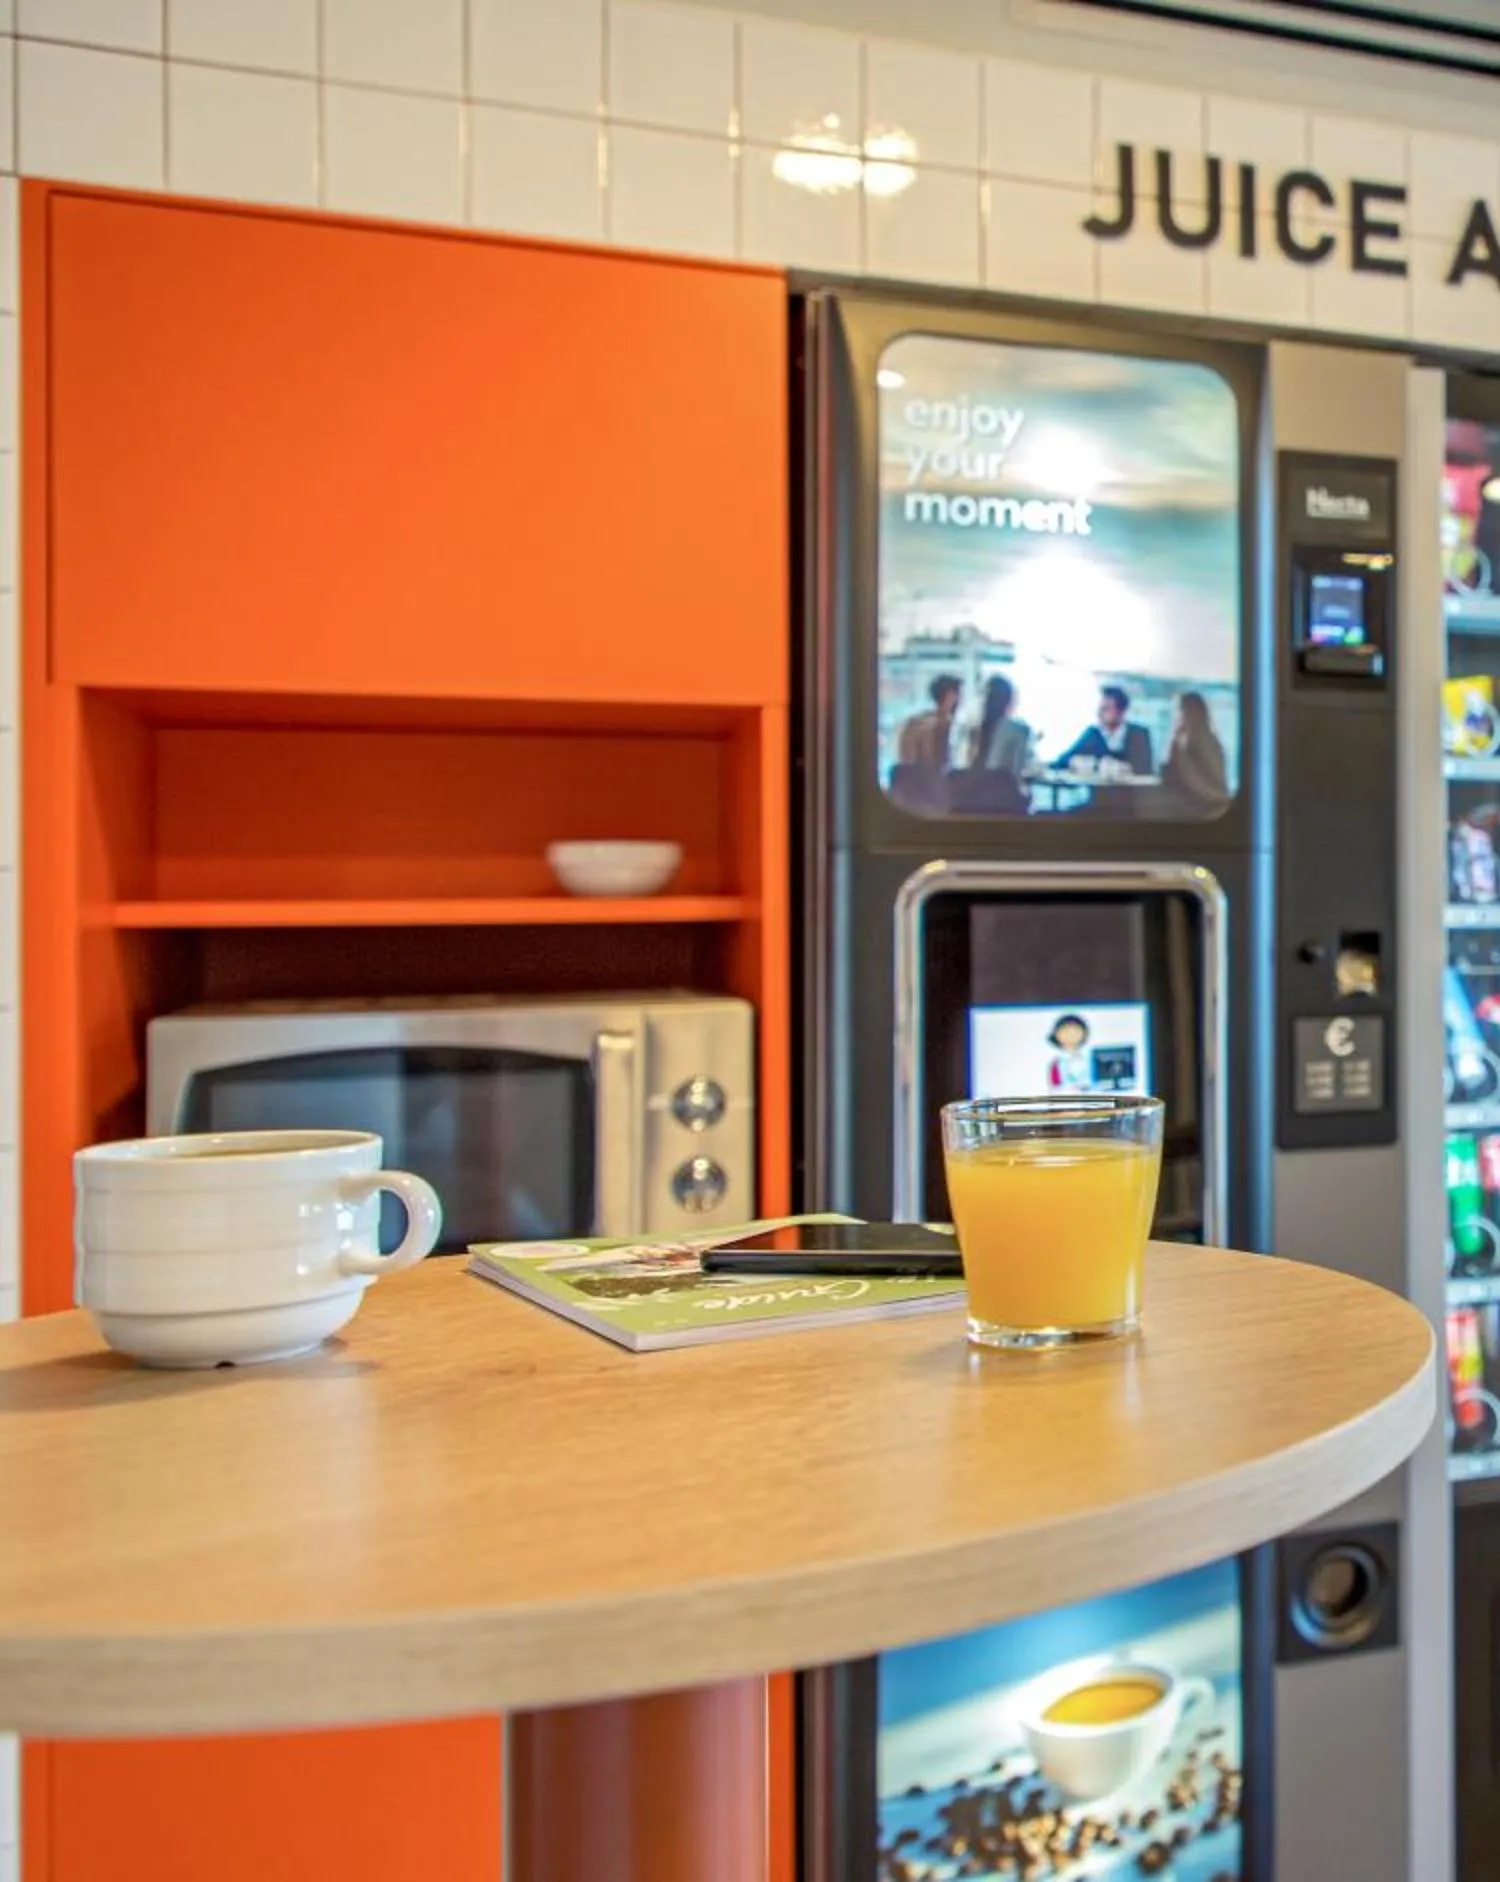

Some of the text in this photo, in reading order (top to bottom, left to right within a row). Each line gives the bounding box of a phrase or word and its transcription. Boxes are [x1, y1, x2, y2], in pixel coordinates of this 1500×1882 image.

[1082, 144, 1407, 276] JUICE
[904, 396, 1025, 445] enjoy
[904, 445, 1005, 482] your
[904, 490, 1093, 535] moment
